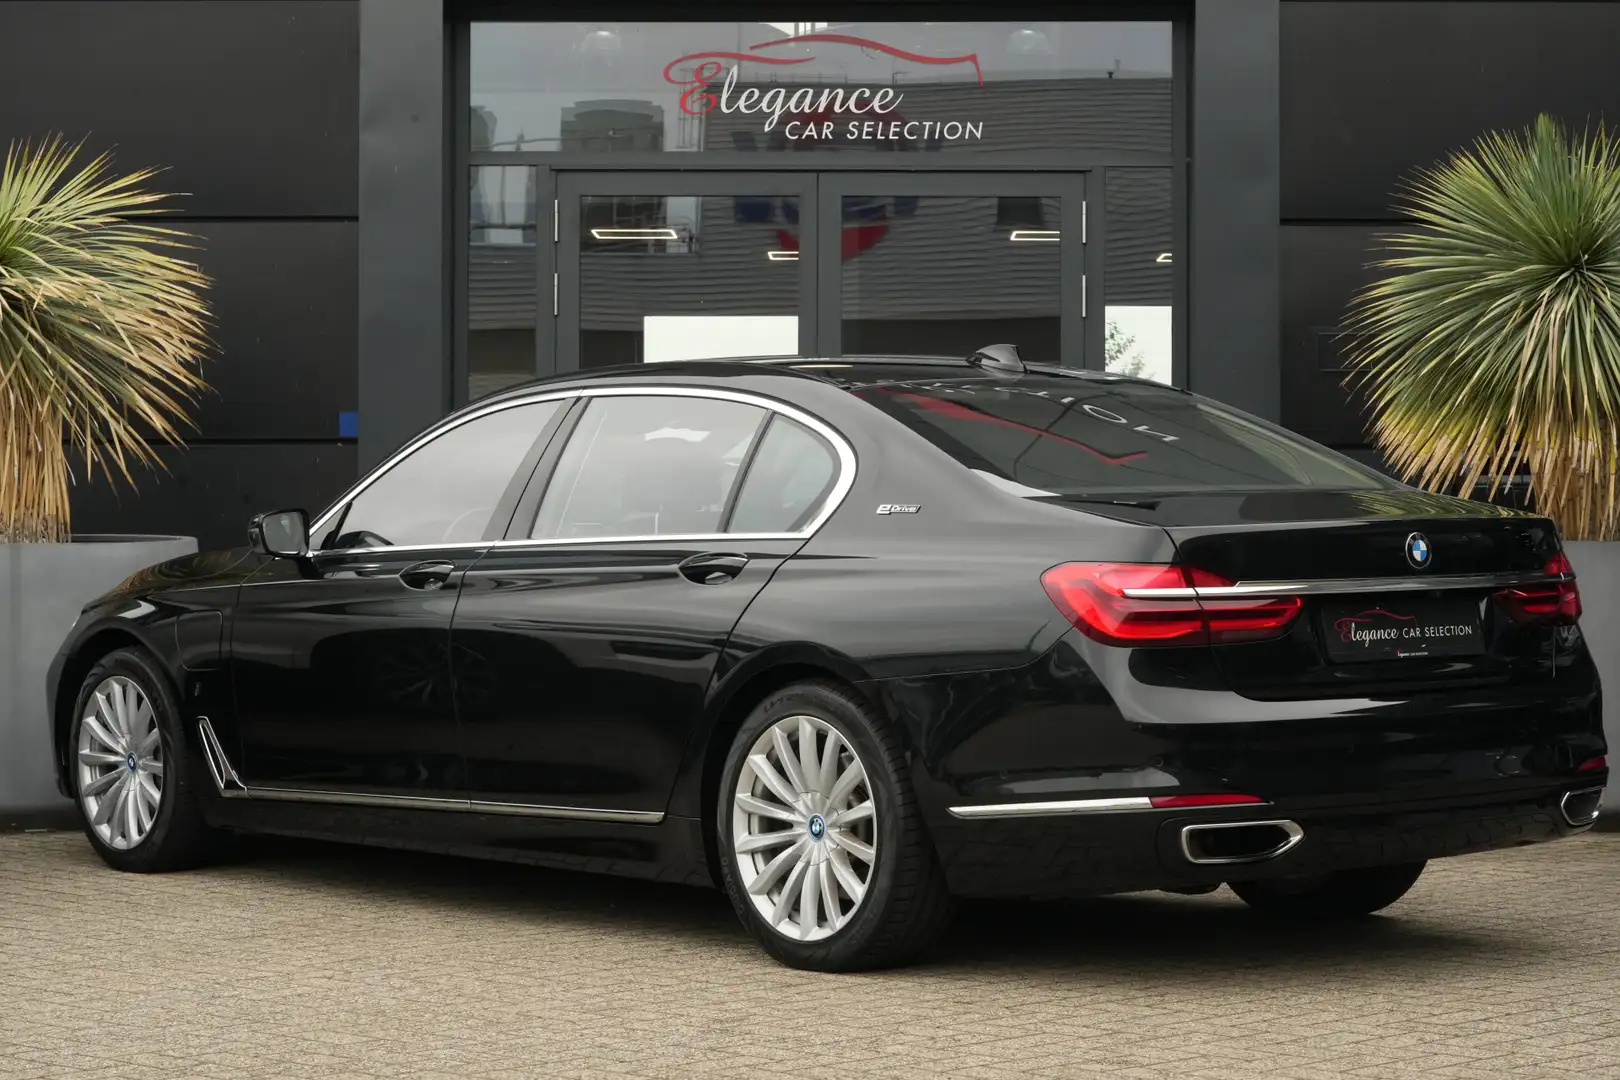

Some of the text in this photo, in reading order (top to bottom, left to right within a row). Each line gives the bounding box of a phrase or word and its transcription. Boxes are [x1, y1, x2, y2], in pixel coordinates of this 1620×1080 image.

[663, 51, 904, 133] Elegance
[785, 120, 984, 140] CAR SELECTION
[1335, 618, 1473, 647] Elegance CAR SELECTION
